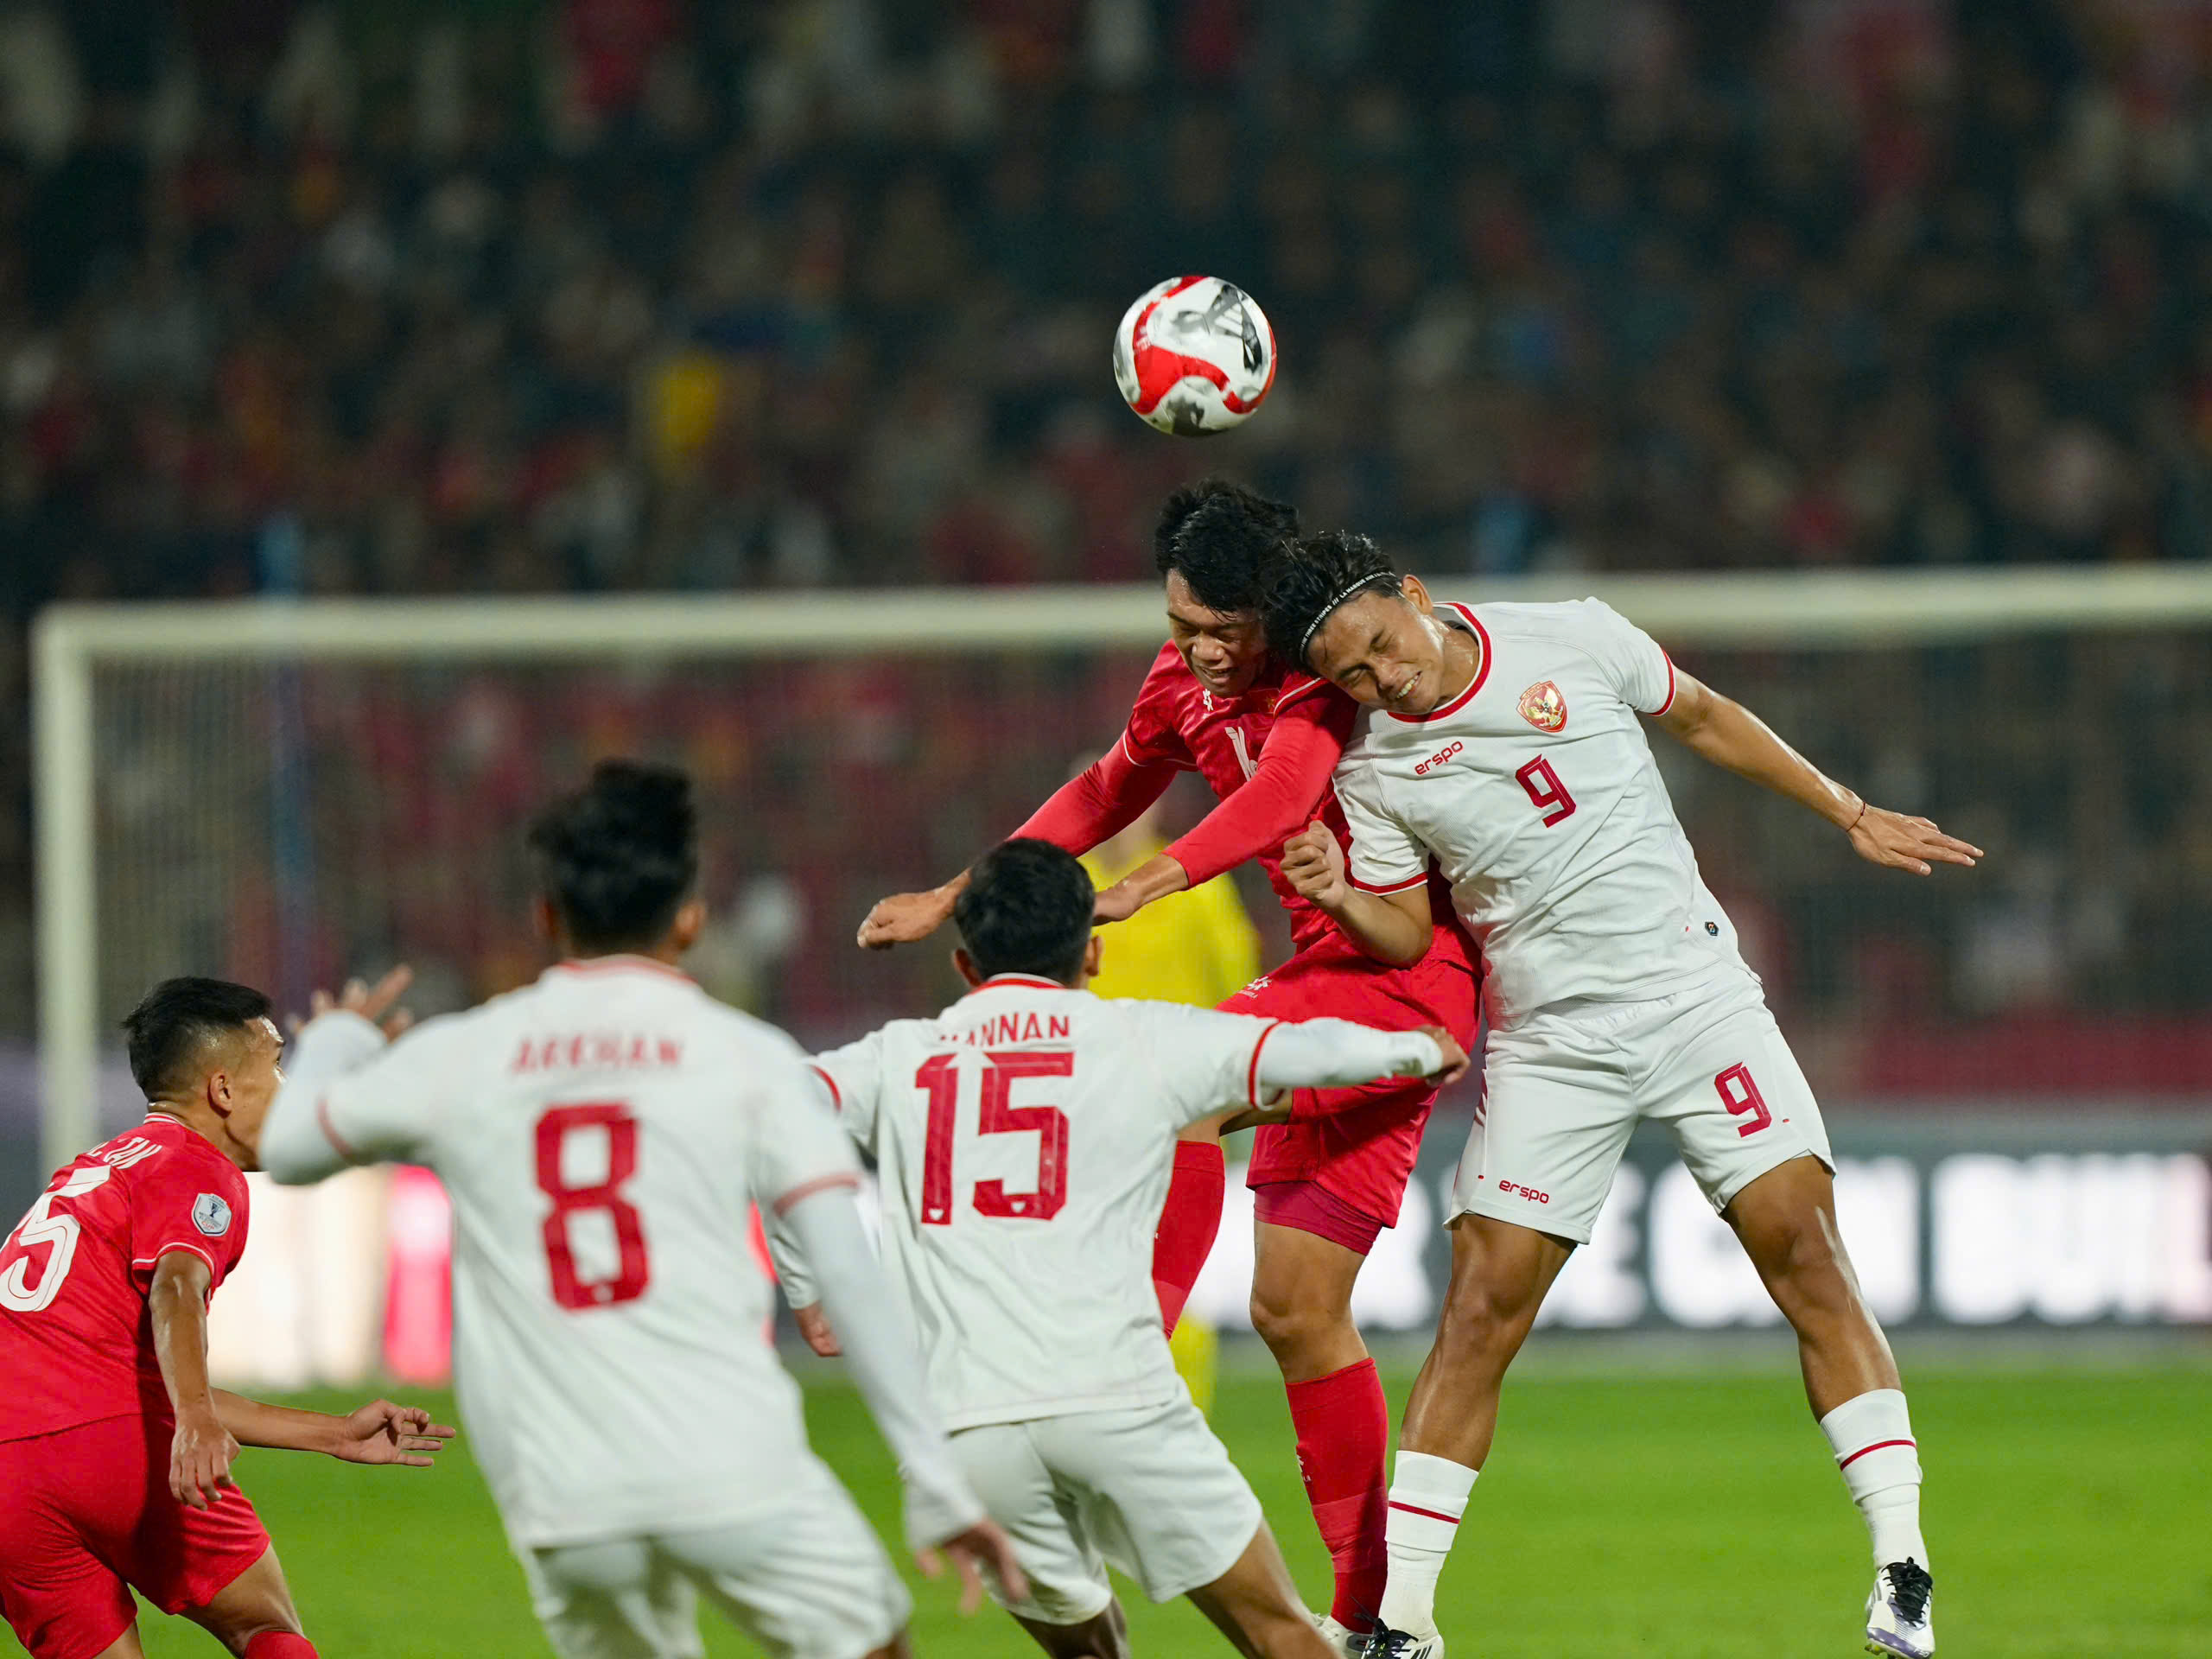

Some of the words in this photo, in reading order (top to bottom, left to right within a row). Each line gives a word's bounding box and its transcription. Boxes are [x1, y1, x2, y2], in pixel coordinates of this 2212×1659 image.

[1314, 605, 1332, 624] STRIPES
[1414, 741, 1464, 775] erspo
[1515, 753, 1577, 829] 9
[940, 1013, 1069, 1047] ANNAN
[1714, 1061, 1772, 1138] 9
[915, 1052, 1075, 1225] 15
[534, 1101, 652, 1312] 8
[1499, 1179, 1549, 1205] erspo
[0, 1164, 111, 1312] 5
